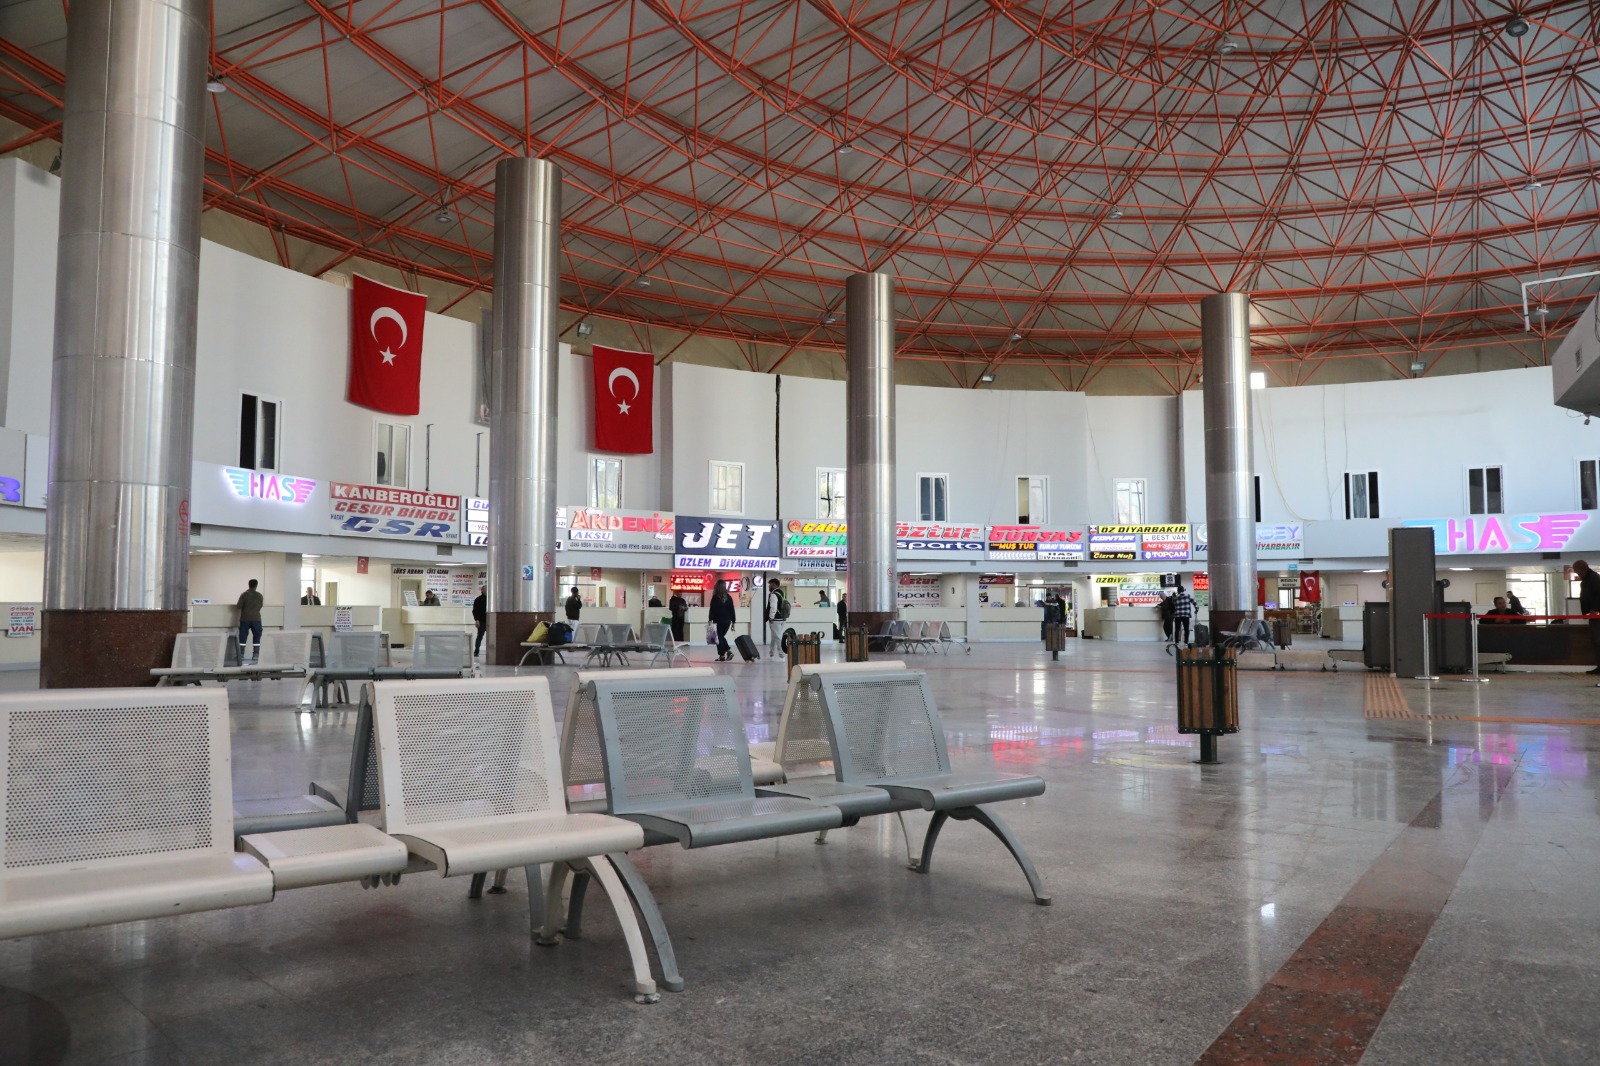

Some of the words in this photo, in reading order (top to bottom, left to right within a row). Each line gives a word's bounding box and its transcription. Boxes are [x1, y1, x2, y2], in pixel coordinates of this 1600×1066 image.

[250, 472, 296, 502] HAS
[334, 484, 458, 509] KANBEROĞLU
[334, 501, 395, 517] CESUR
[397, 506, 457, 523] BİNGÖL
[570, 508, 674, 534] AKDENİZ
[340, 515, 451, 538] CSR
[573, 531, 612, 540] AKSU
[682, 522, 772, 550] JET
[1448, 515, 1541, 552] HAS
[788, 535, 823, 545] HAS
[1018, 542, 1035, 550] TUR
[11, 625, 34, 633] VAN
